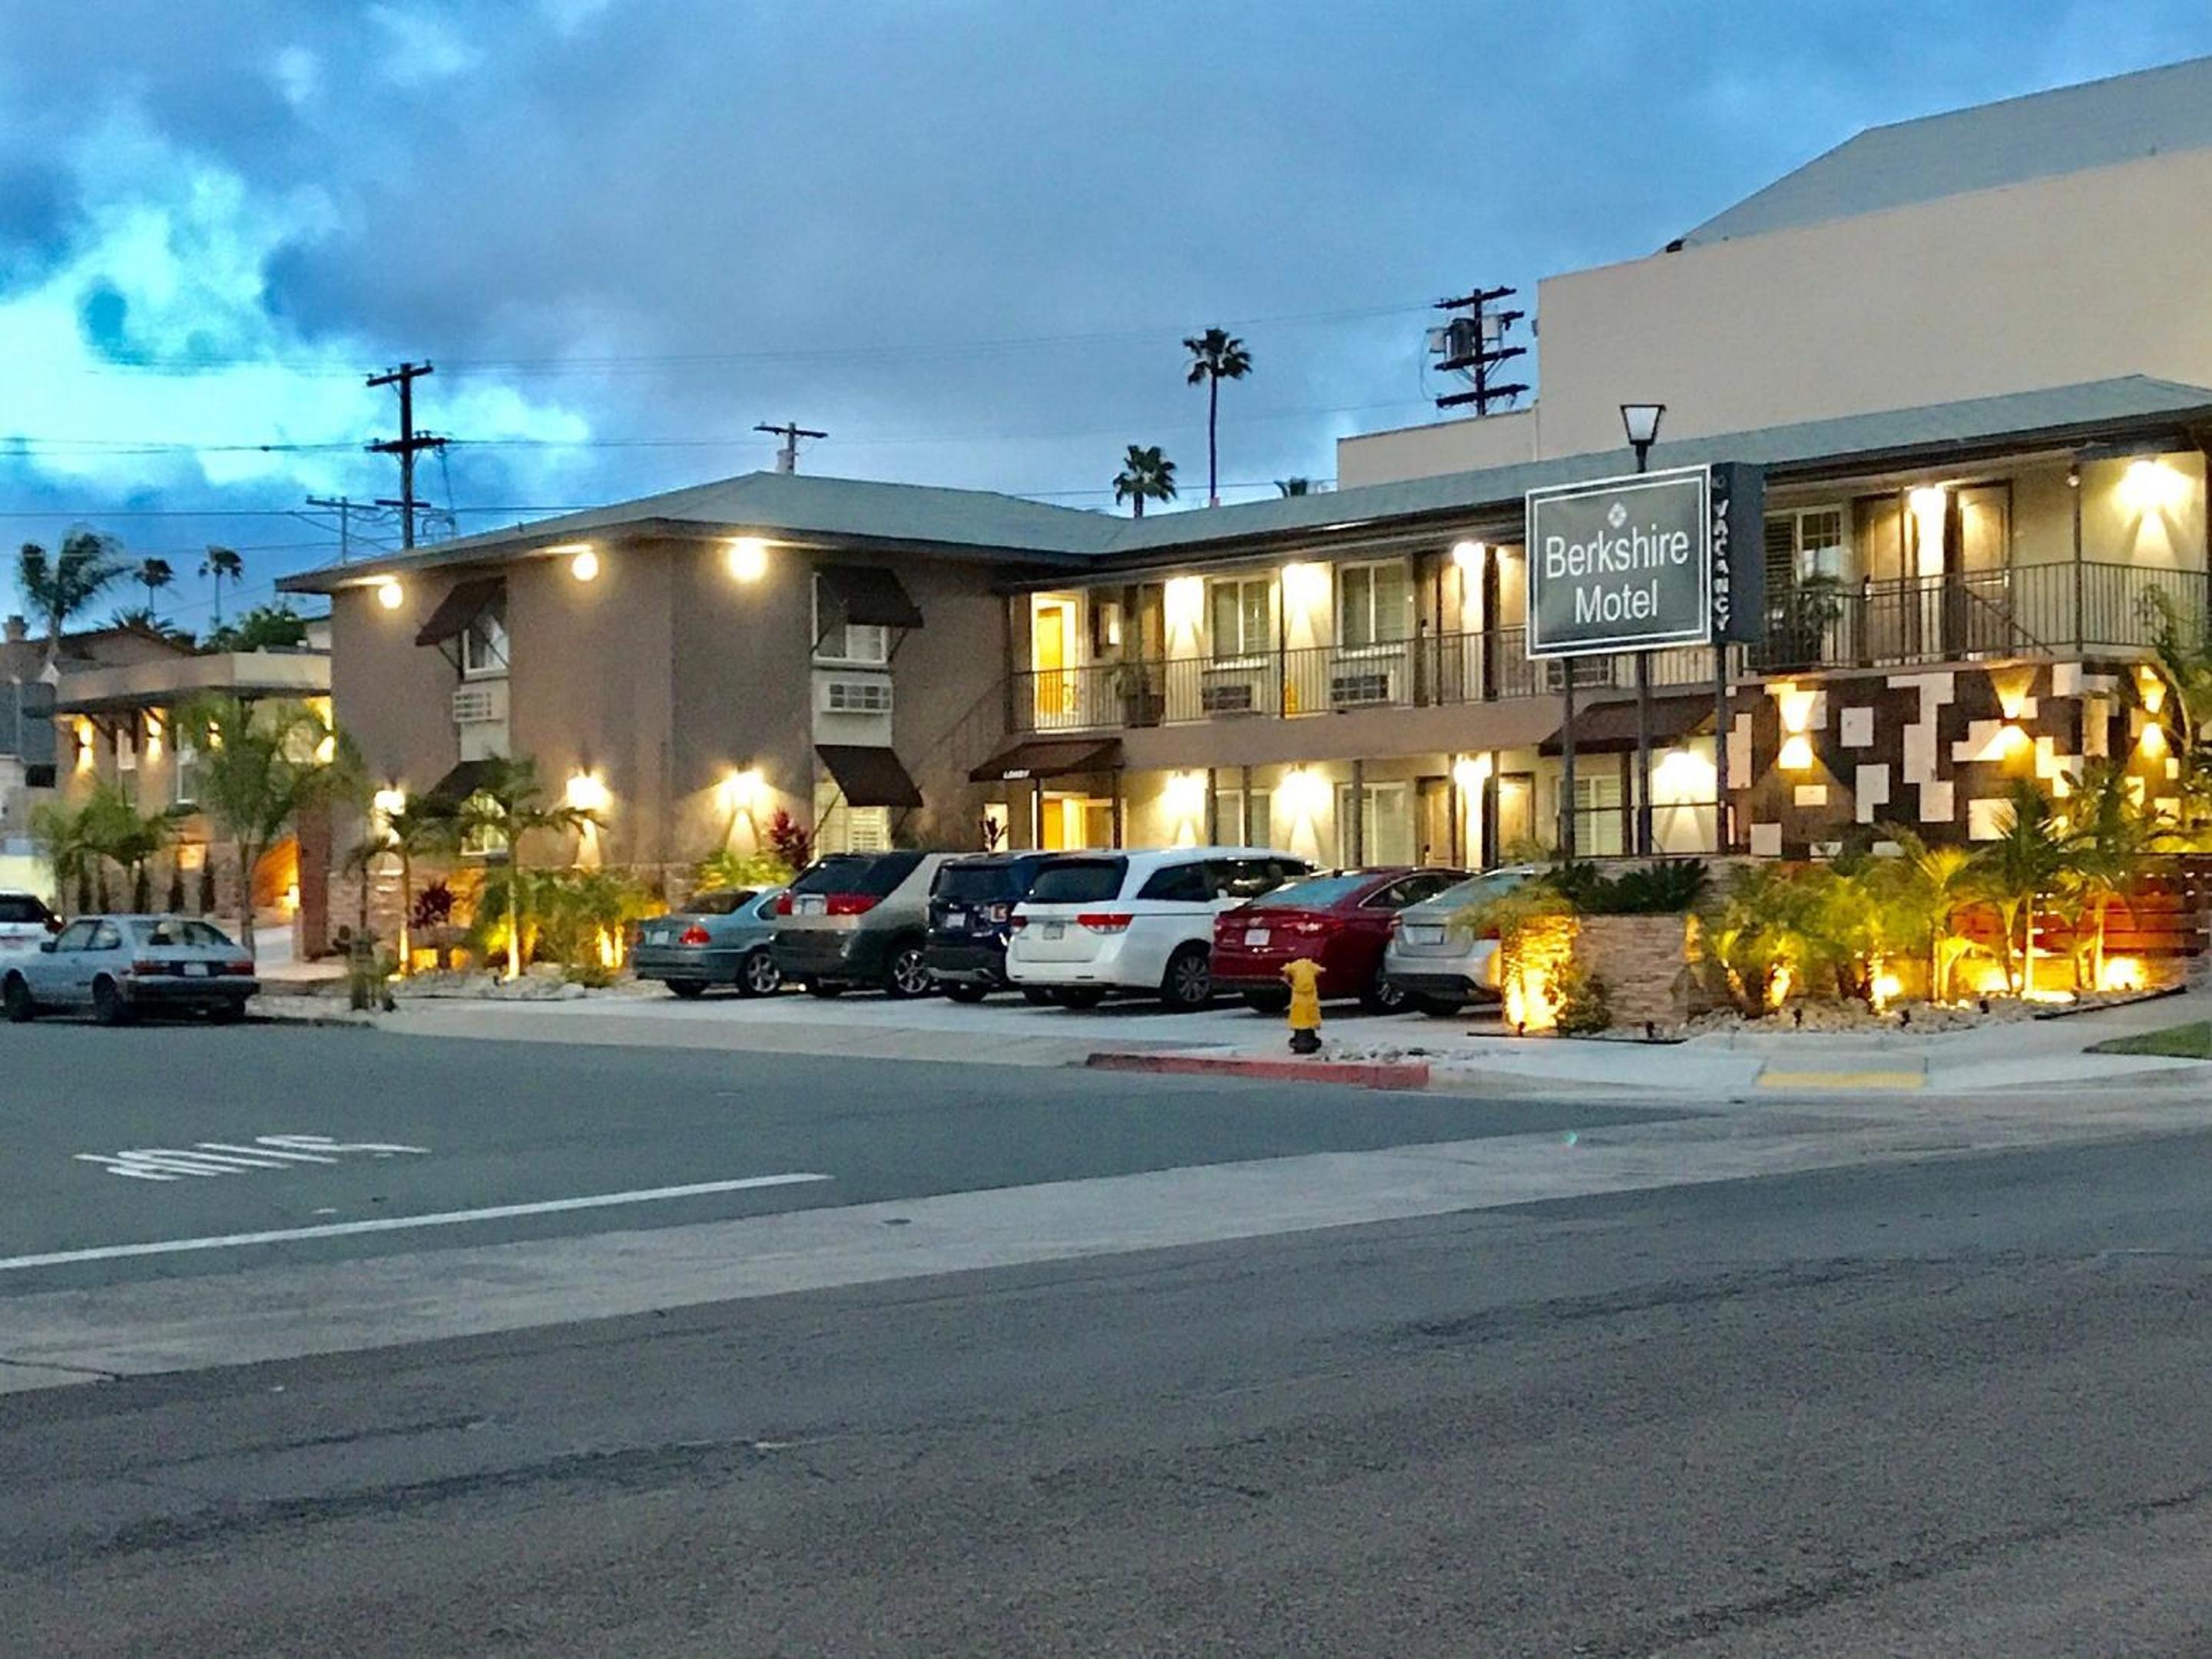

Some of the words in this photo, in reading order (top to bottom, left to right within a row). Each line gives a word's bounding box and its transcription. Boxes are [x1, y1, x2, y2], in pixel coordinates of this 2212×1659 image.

[1545, 523, 1690, 578] Berkshire
[1713, 499, 1730, 631] VACANCY
[1575, 579, 1658, 624] Motel
